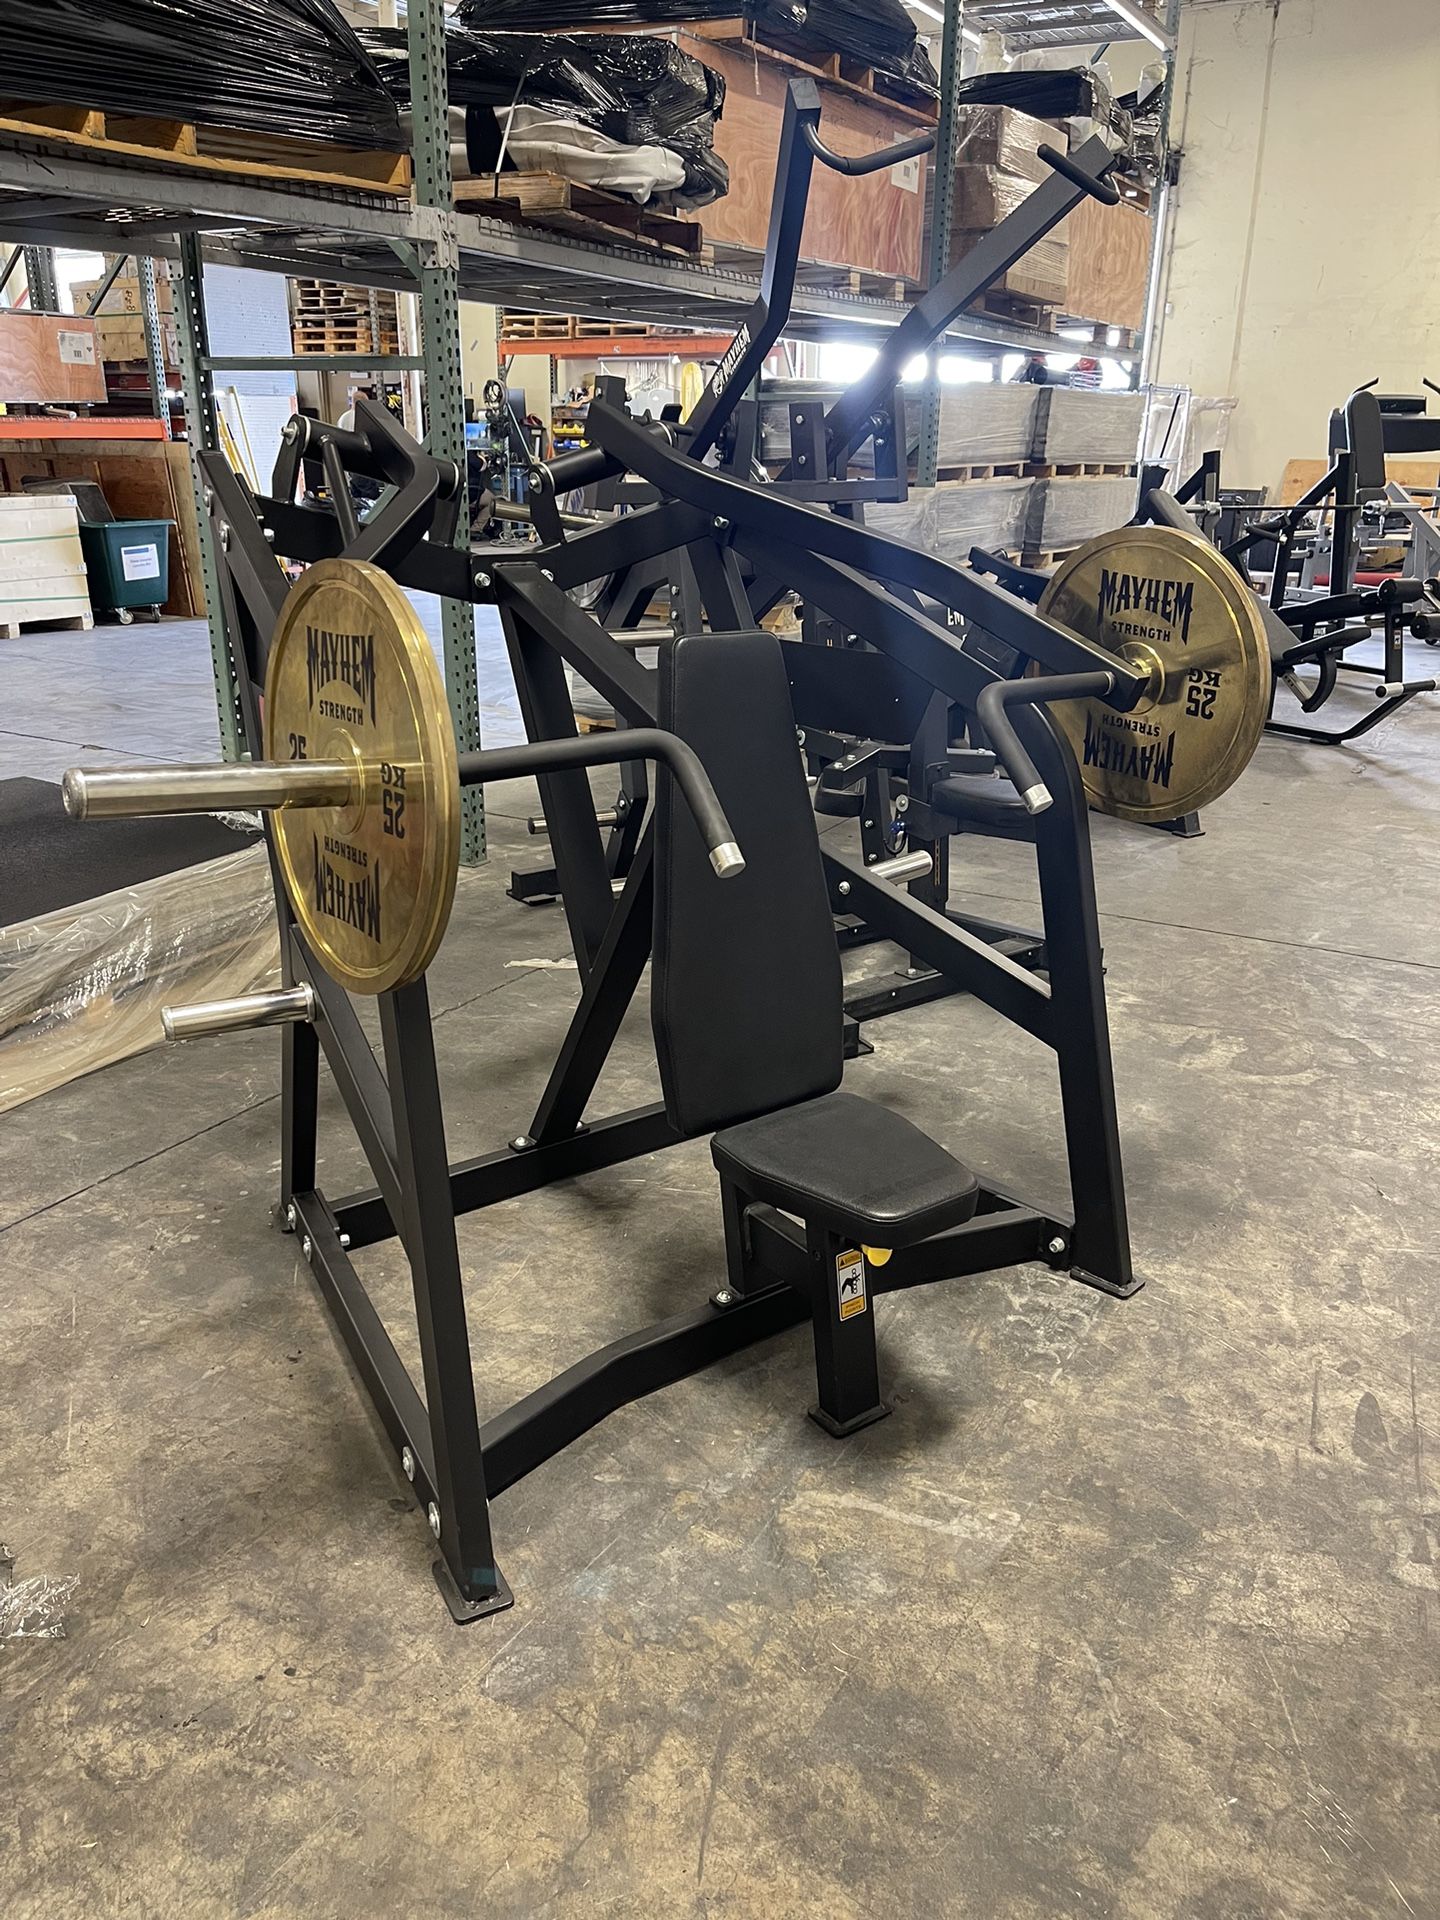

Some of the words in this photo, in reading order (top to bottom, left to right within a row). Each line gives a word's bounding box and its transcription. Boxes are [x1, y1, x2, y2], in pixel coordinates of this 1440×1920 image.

[720, 323, 751, 382] MAYHEM
[1098, 569, 1194, 645] MAYHEM
[1111, 621, 1171, 642] STRENGTH
[306, 625, 377, 729] MAYHEM
[1188, 668, 1222, 687] KG
[319, 700, 364, 726] STRENGTH
[1186, 685, 1218, 719] 25
[1103, 715, 1160, 738] STRENGTH
[1084, 711, 1176, 789] MAYHEM
[380, 762, 406, 789] KG
[383, 788, 405, 839] 25
[323, 835, 368, 868] STRENGTH
[314, 832, 381, 944] MAYHEM
